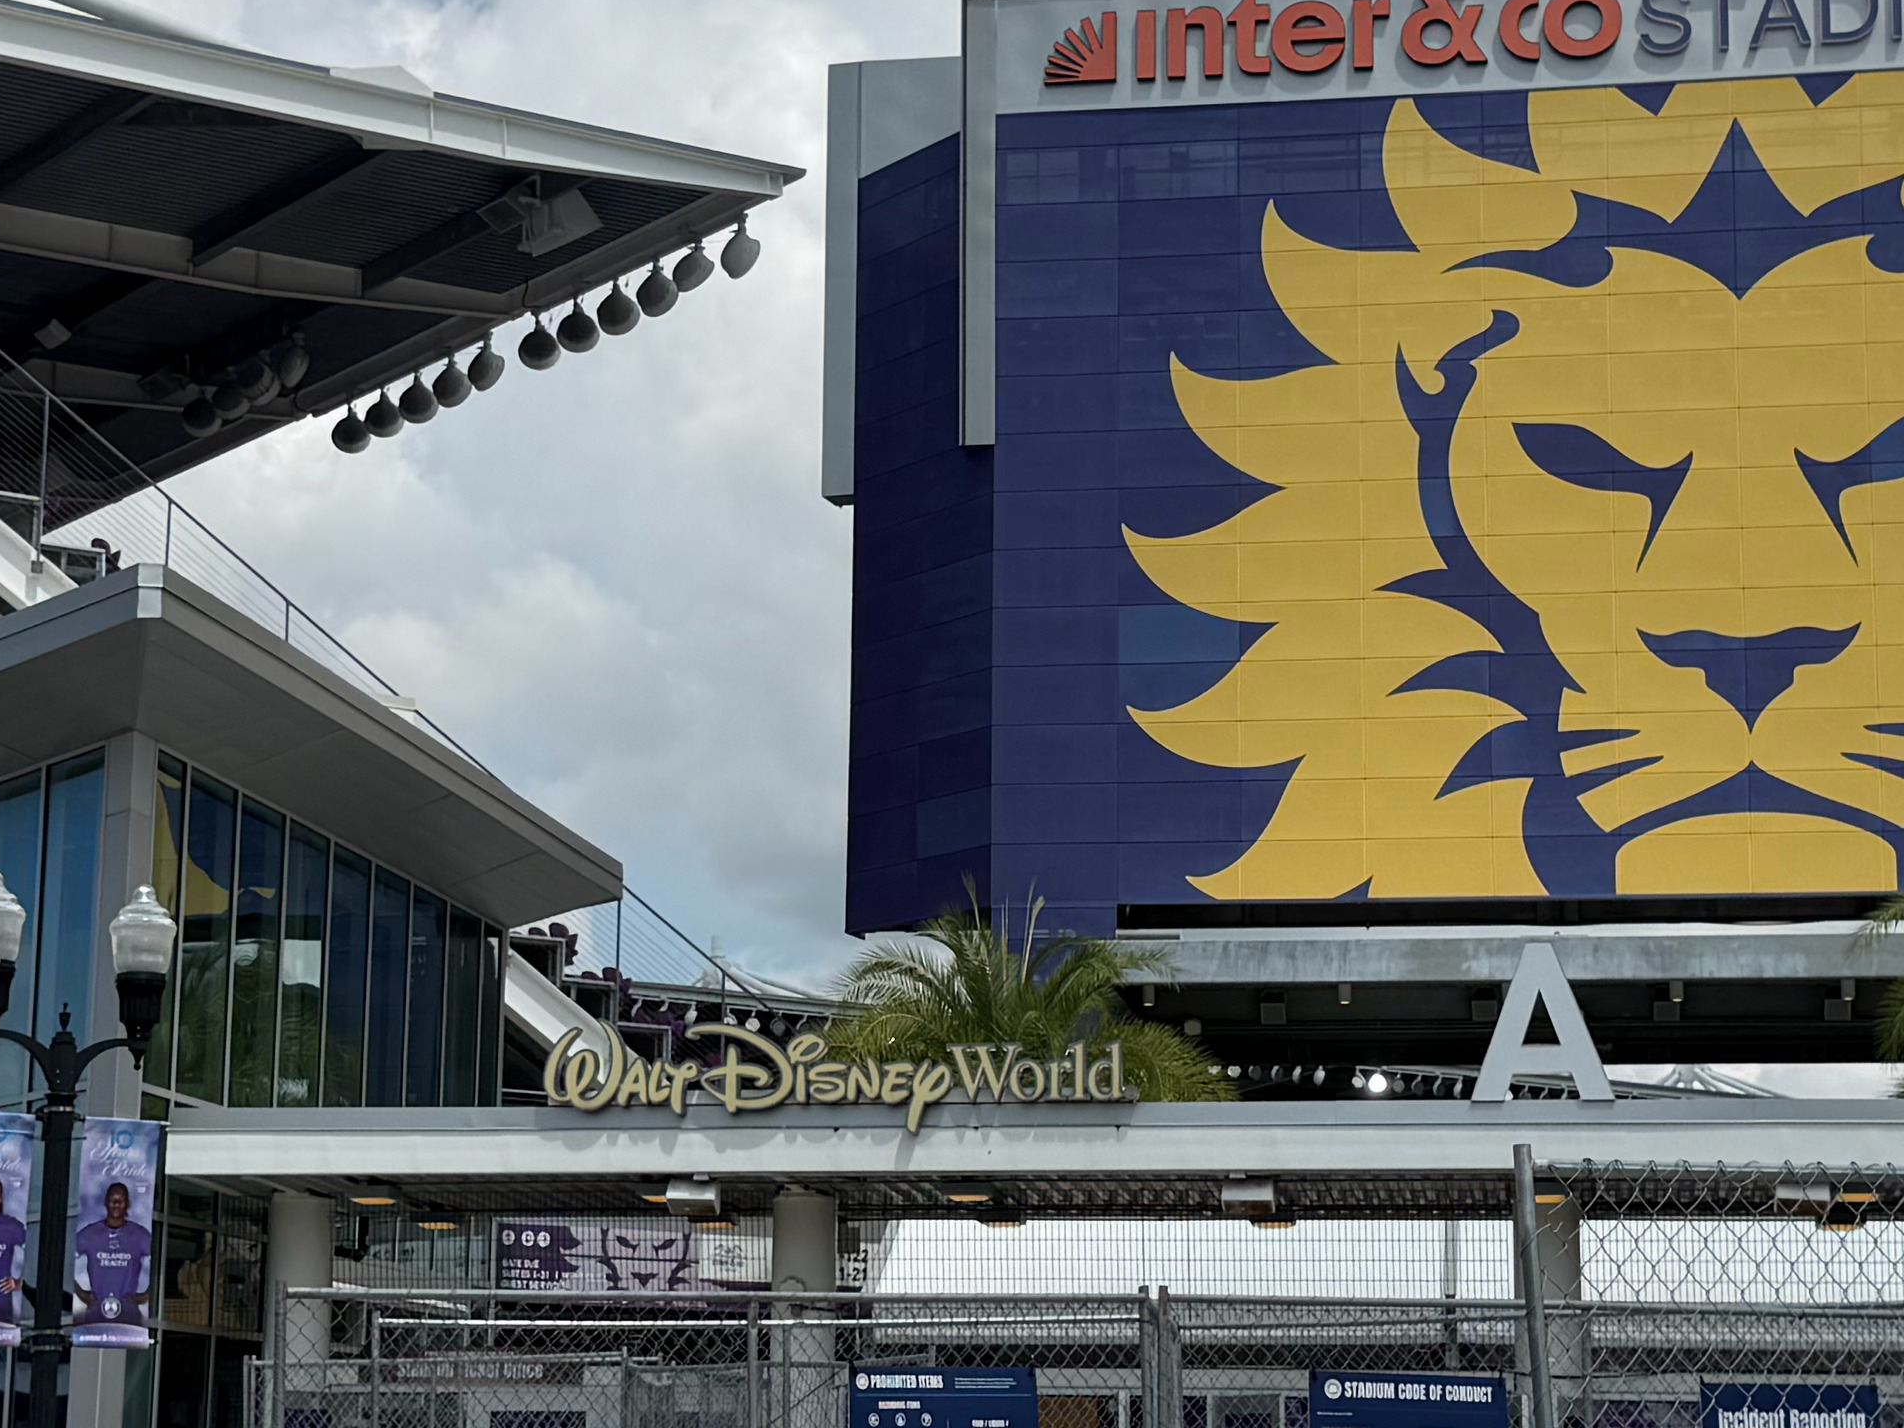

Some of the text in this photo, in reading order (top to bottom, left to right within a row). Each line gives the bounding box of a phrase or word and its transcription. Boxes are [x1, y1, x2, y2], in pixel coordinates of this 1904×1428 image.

[1471, 941, 1616, 1102] A
[947, 1039, 1125, 1104] World
[870, 1375, 917, 1389] PROHIBITED
[918, 1375, 944, 1389] ITEMS
[1344, 1381, 1493, 1403] STADIUM CODE OF CONDUCT
